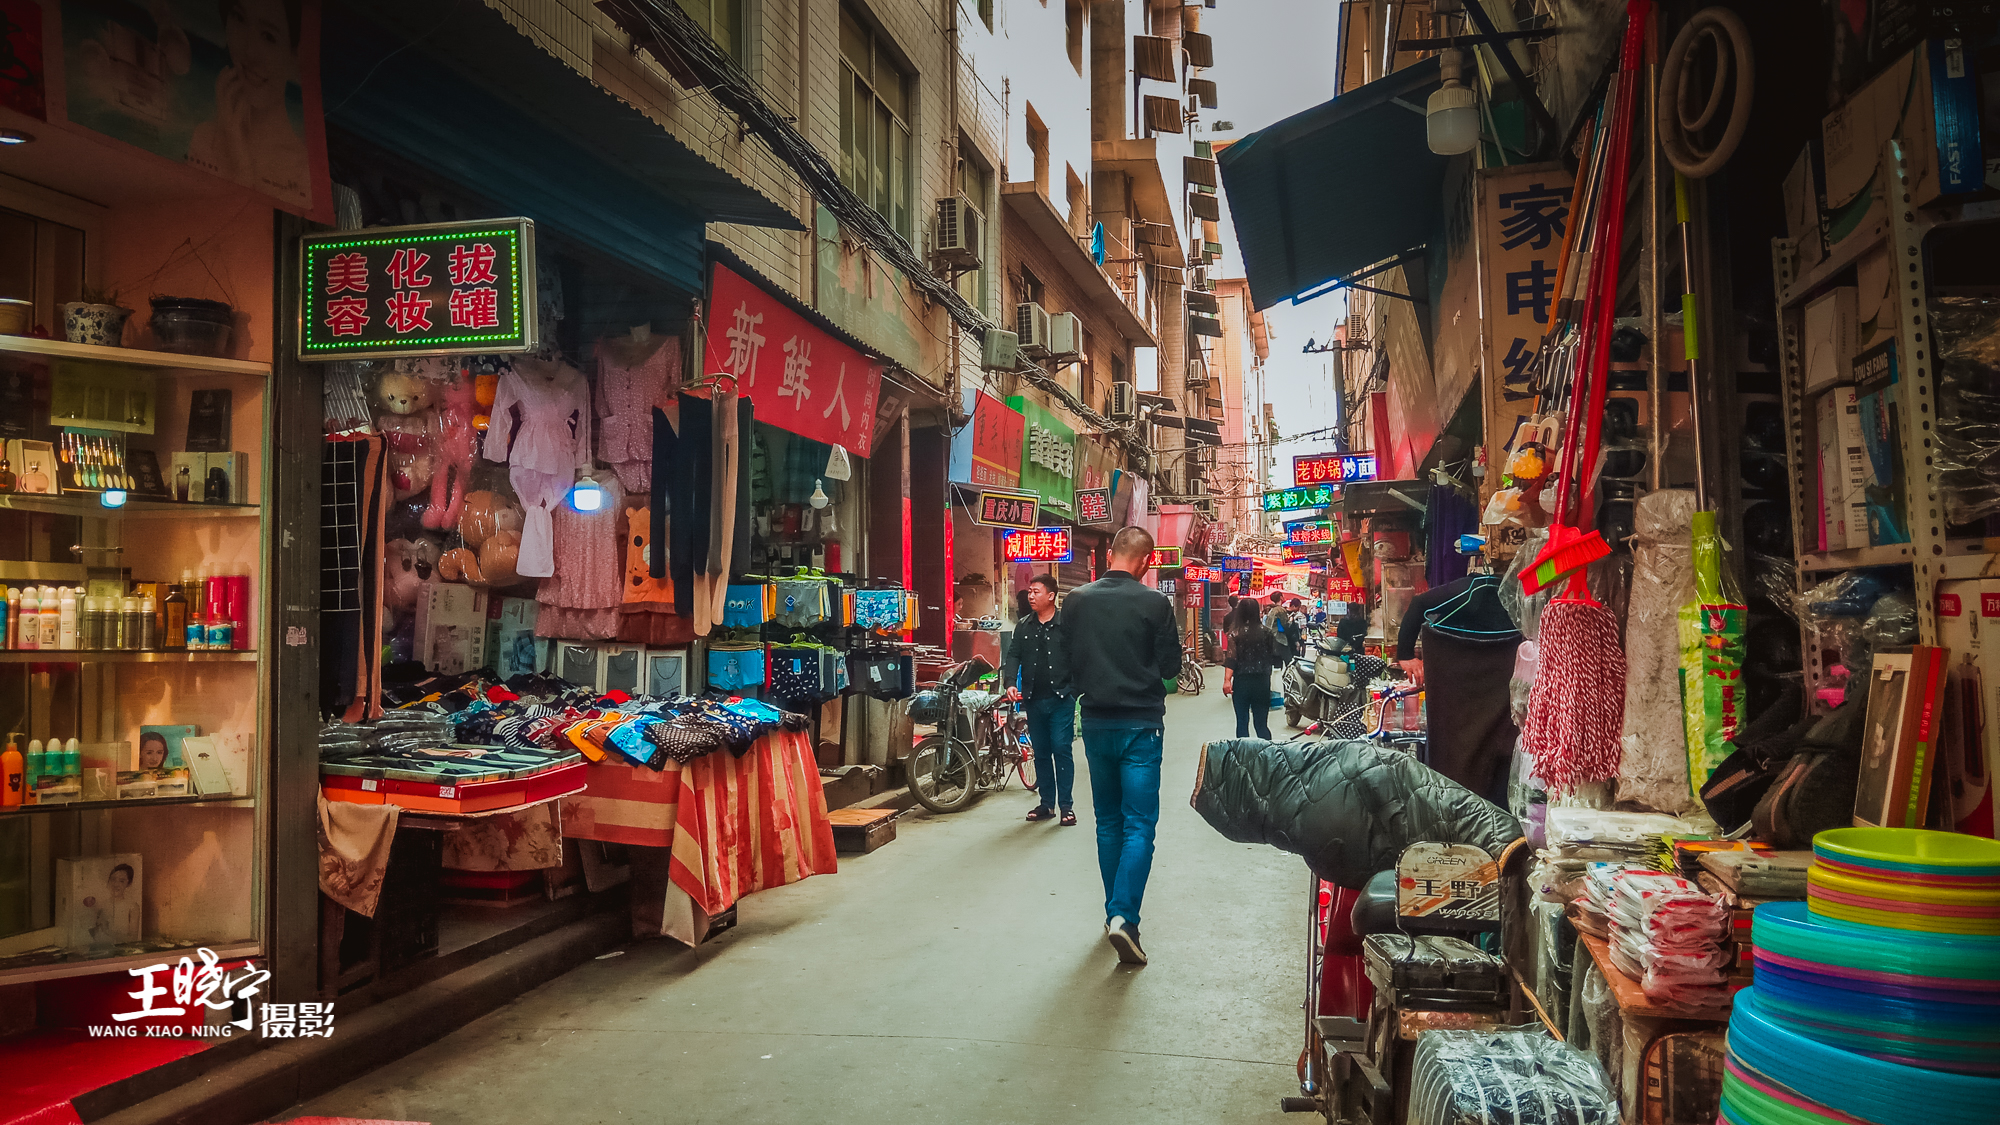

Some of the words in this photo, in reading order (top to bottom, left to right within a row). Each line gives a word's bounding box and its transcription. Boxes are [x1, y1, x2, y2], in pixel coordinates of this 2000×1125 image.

[724, 300, 850, 432] 新鲜人
[857, 366, 876, 452] 时尚内衣
[1297, 456, 1377, 481] 老砂锅炒面
[983, 498, 1034, 524] 重庆小面
[1079, 493, 1107, 521] 鞋
[1007, 531, 1068, 559] 减肥养生
[1290, 529, 1331, 543] 过桥米线
[1427, 856, 1467, 867] GREEN
[1415, 879, 1483, 901] 王野
